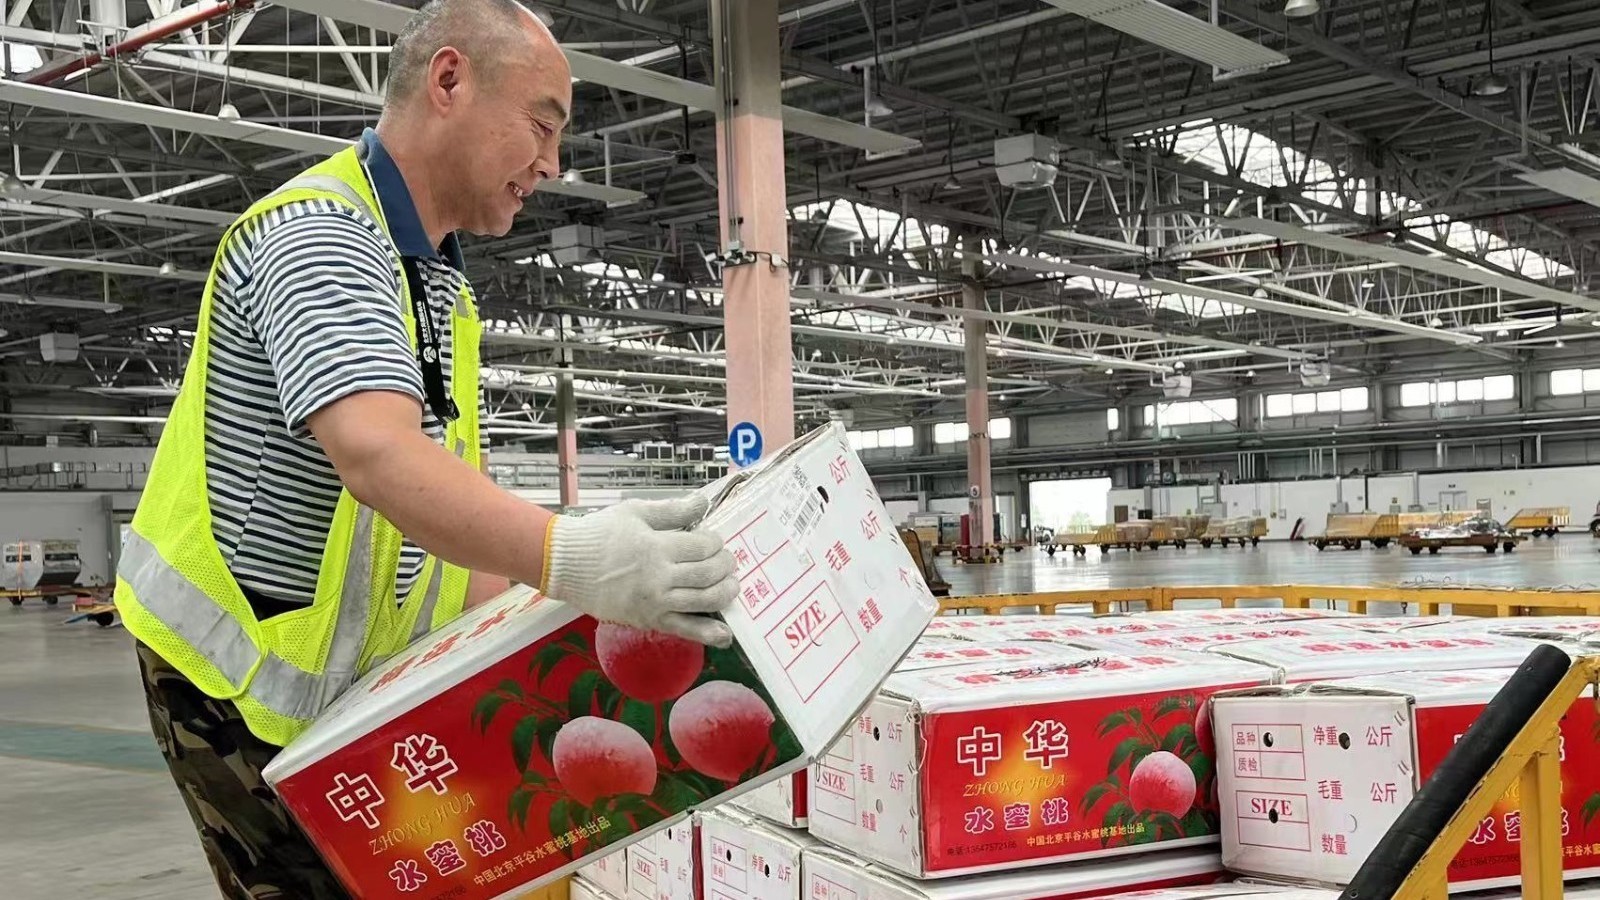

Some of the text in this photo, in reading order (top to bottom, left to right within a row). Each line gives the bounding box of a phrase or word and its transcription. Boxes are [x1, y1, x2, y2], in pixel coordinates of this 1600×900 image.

[737, 429, 756, 461] P
[828, 455, 851, 485] 公斤
[860, 510, 882, 540] 公斤
[824, 540, 852, 571] 毛重
[899, 567, 910, 588] 个
[743, 578, 770, 608] 质检
[784, 600, 827, 649] SIZE
[857, 597, 884, 634] 数量
[887, 722, 903, 743] 公斤
[1236, 731, 1256, 746] 品种
[1313, 725, 1339, 746] 净重
[1366, 725, 1393, 747] 公斤
[957, 720, 1069, 776] 中华
[860, 763, 874, 783] 毛重
[1238, 757, 1258, 773] 质检
[326, 733, 459, 829] 中华
[822, 771, 846, 792] SIZE
[889, 771, 905, 792] 公斤
[963, 774, 1066, 797] ZHONG HUA
[1317, 780, 1343, 800] 毛重
[1370, 782, 1398, 804] 公斤
[965, 797, 1069, 833] 水蜜桃
[1251, 797, 1293, 816] SIZE
[368, 792, 477, 856] ZHONG HUA
[1026, 823, 1145, 847] 中国北京平谷水蜜桃基地出品
[388, 819, 507, 892] 水蜜桃
[473, 815, 611, 887] 中国北京平谷水蜜桃基地出品
[1321, 833, 1348, 856] 数量
[637, 859, 652, 877] SIZE
[777, 864, 791, 882] 公斤
